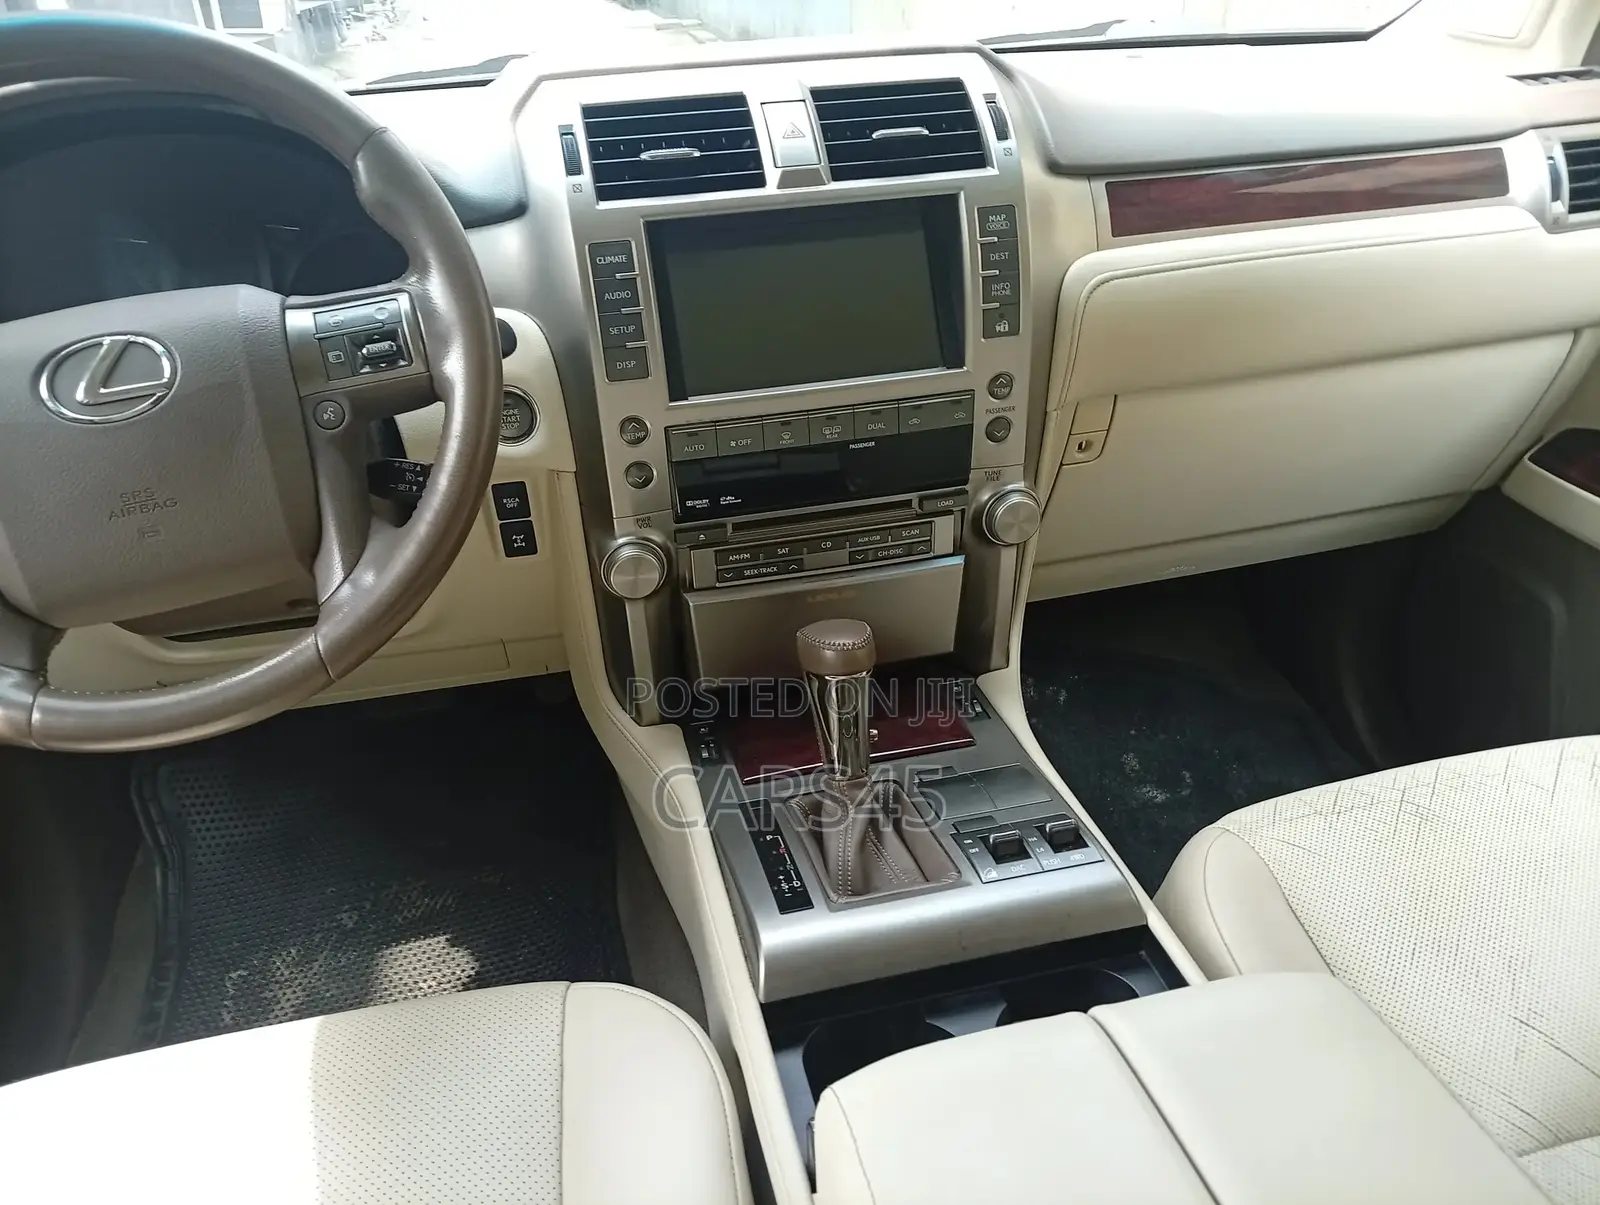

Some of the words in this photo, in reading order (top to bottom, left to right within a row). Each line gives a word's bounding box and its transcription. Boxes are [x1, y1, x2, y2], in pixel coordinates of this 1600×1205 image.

[989, 214, 1006, 222] MAP
[990, 222, 1008, 230] VOICE
[596, 254, 628, 264] CLIMATE
[990, 252, 1009, 261] DEST
[992, 282, 1011, 290] INFO
[604, 290, 631, 300] AUDIO
[609, 325, 636, 334] SETUP
[369, 343, 389, 352] ENTER
[616, 360, 636, 369] DISP
[993, 386, 1011, 395] TEMP
[502, 408, 520, 416] NGINE
[985, 405, 1016, 415] PASSENGER
[501, 415, 521, 423] TART
[501, 422, 520, 430] STOP
[867, 422, 886, 430] DUAL
[627, 431, 646, 440] TEMP
[737, 438, 752, 447] OFF
[849, 441, 876, 449] PASSENGER
[684, 443, 705, 452] AUTO
[401, 462, 414, 470] RES
[984, 469, 1002, 477] TUNE
[397, 483, 410, 491] SET
[937, 499, 954, 508] LOAD
[108, 497, 179, 521] AIRBAG
[636, 516, 652, 524] PWR
[901, 528, 920, 537] SCAN
[821, 541, 832, 549] CD
[777, 547, 790, 555] SAT
